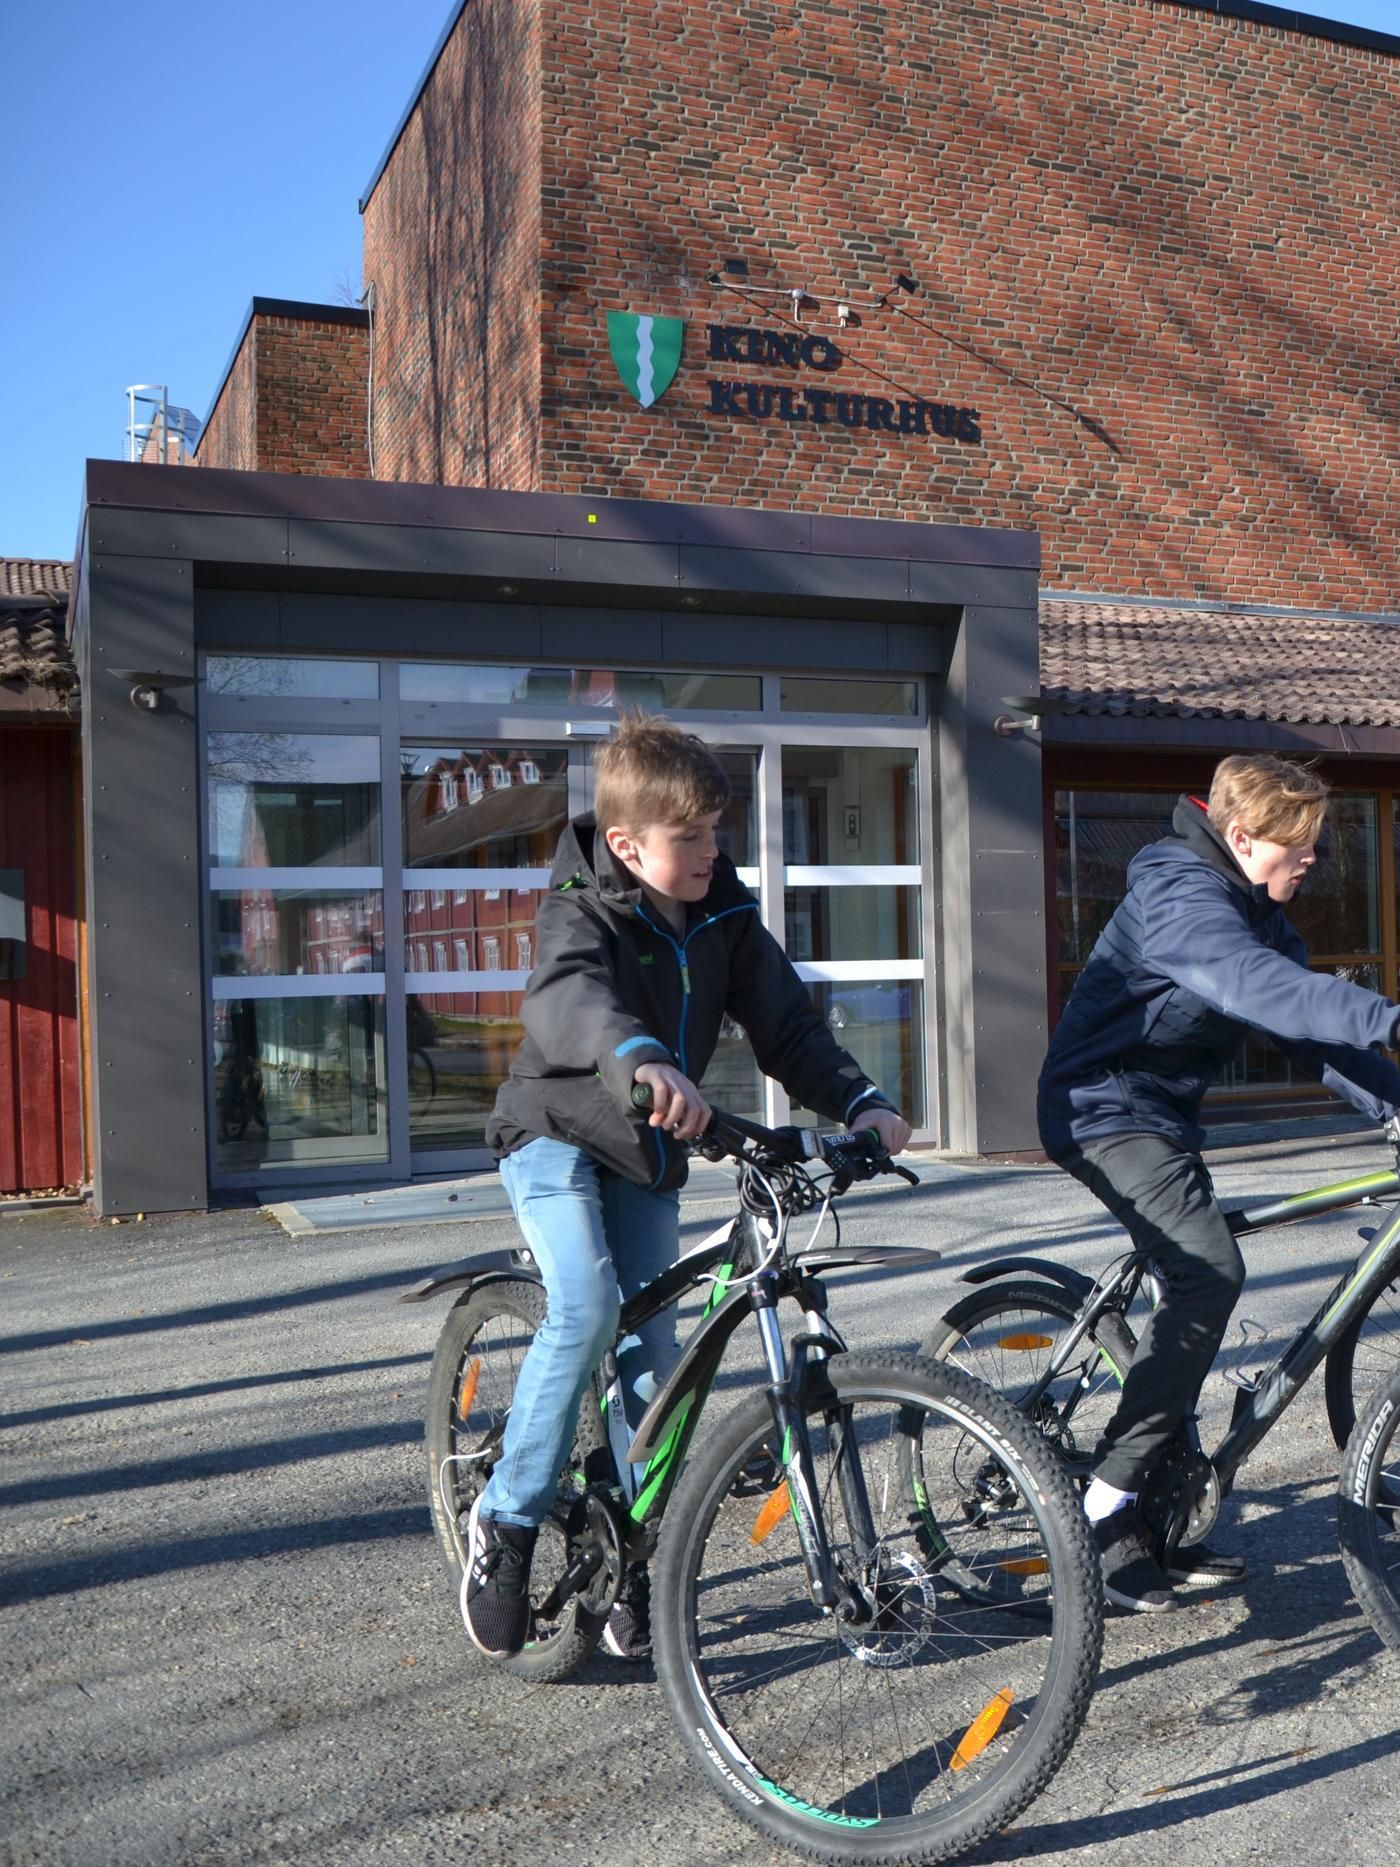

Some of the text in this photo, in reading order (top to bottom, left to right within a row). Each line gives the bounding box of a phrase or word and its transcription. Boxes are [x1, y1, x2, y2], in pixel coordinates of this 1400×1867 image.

[707, 324, 838, 371] KINO
[707, 380, 980, 442] KULTURHUS
[1353, 1399, 1394, 1507] MERIDA
[696, 1728, 763, 1806] KENDATIRE.COM
